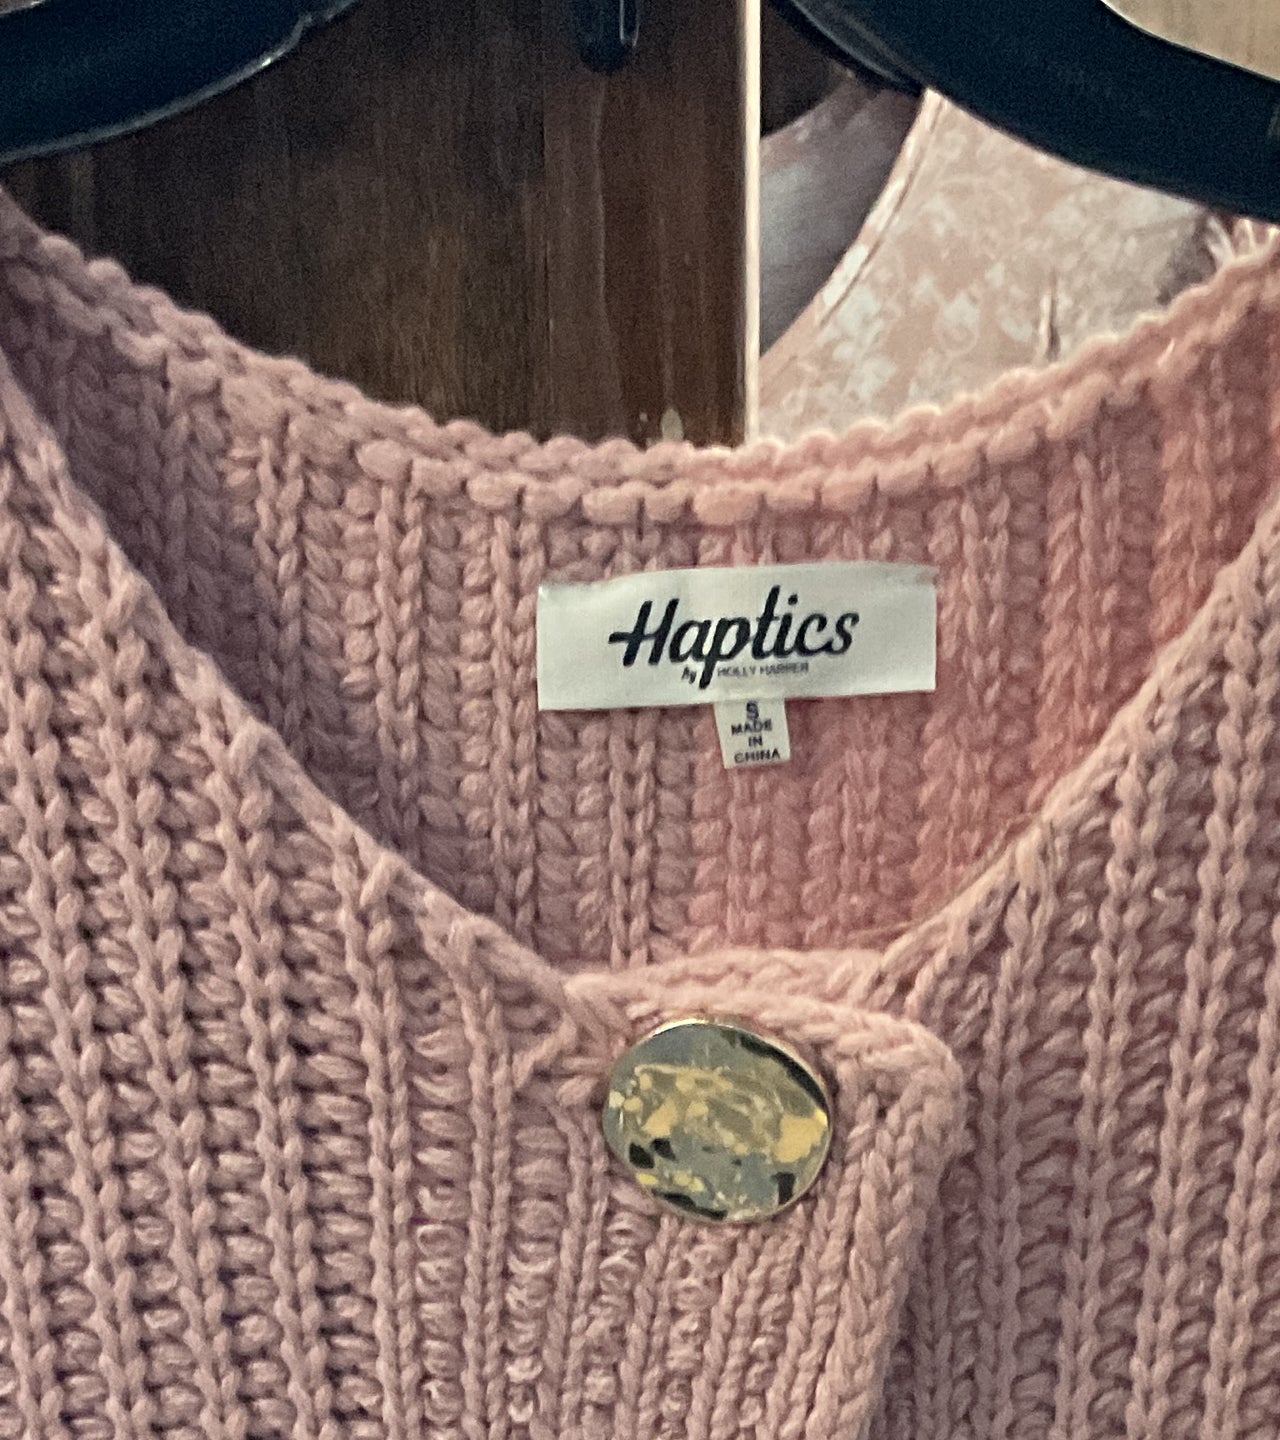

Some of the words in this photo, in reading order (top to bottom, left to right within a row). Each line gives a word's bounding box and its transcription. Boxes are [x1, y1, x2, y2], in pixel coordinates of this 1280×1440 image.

[608, 585, 859, 689] Haptics
[746, 701, 759, 719] S
[731, 719, 772, 735] MADE
[748, 735, 763, 747] IN
[734, 748, 780, 763] CHINA
